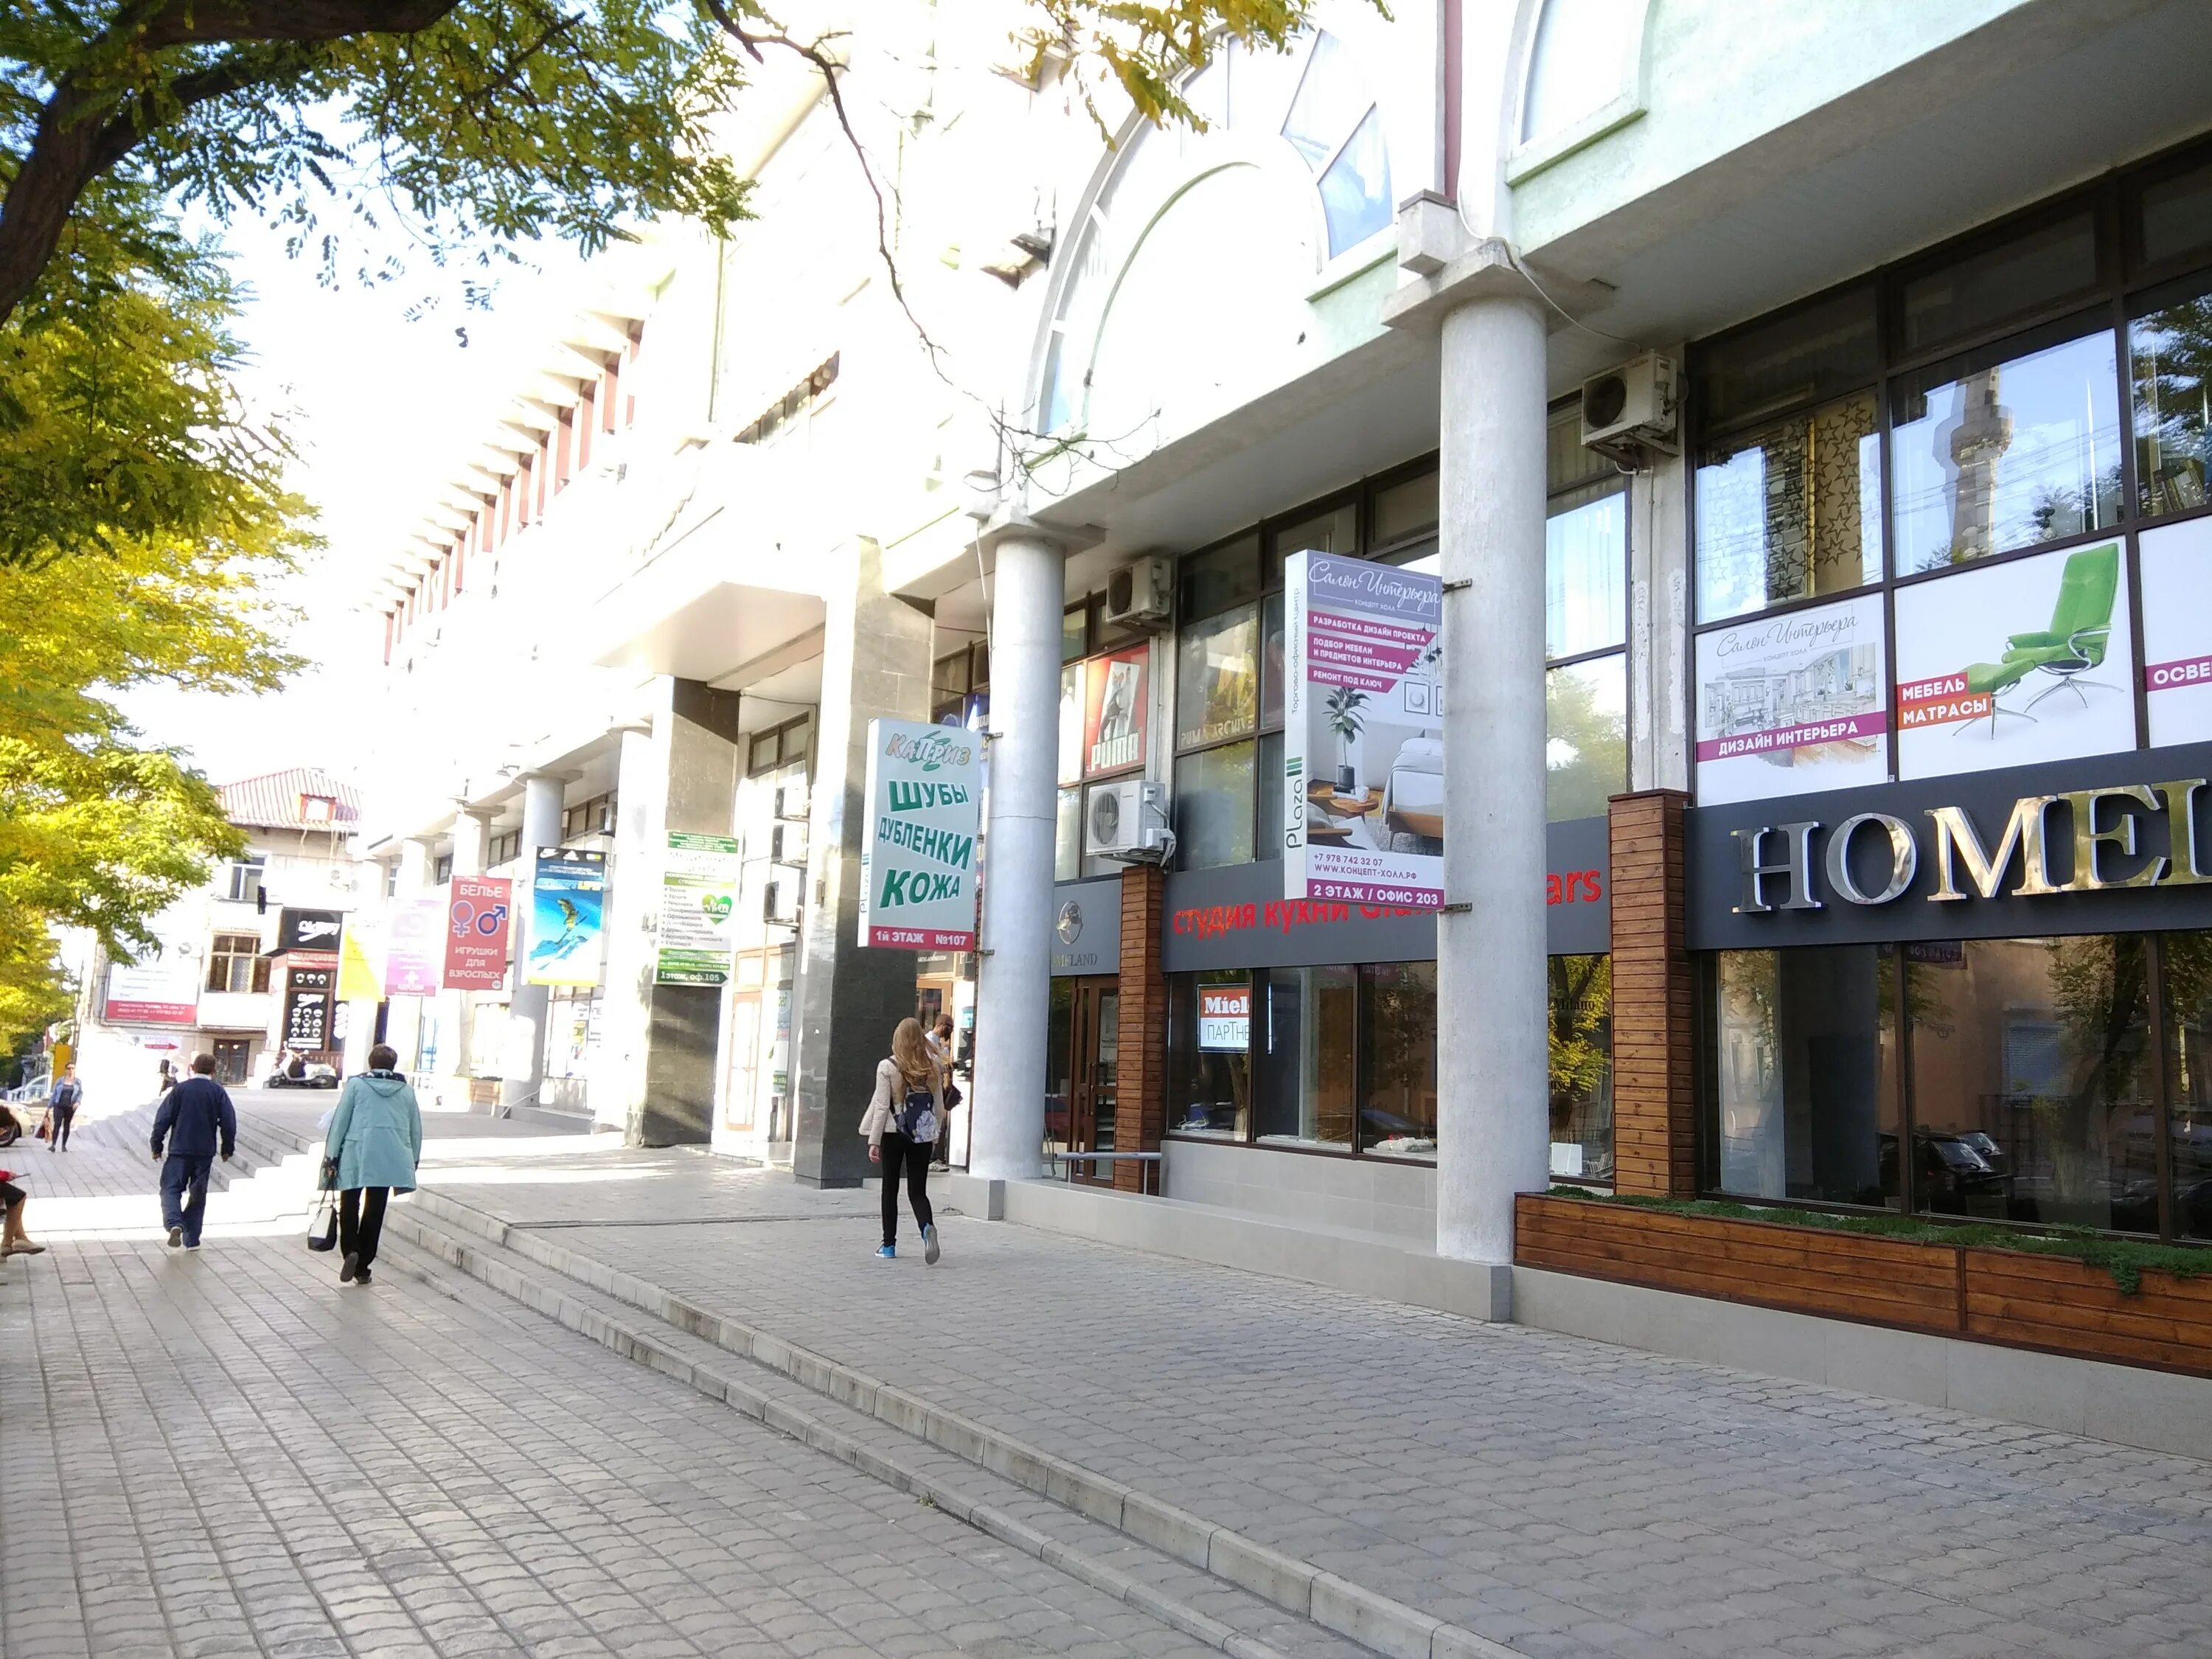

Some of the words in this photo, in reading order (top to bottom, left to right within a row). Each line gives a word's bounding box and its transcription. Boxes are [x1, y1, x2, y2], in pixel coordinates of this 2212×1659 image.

[1308, 561, 1360, 589] Салон
[1358, 571, 1440, 612] Интерьера
[1354, 599, 1379, 609] КОНЦЕПТ
[1380, 603, 1396, 612] ХОЛЛ
[1313, 616, 1362, 632] РАЗРАБОТКА
[1363, 625, 1392, 637] ДИЗАЙН
[1393, 630, 1426, 642] ПРОЕКТА
[1717, 633, 1767, 657] Салон
[1766, 615, 1859, 647] Интерьера
[1313, 637, 1343, 650] ПОДБОР
[1345, 643, 1373, 655] МЕБЕЛИ
[1763, 650, 1790, 662] КОНЦЕПТ
[1320, 650, 1362, 664] ПРЕДМЕТОВ
[1363, 658, 1402, 670] ИНТЕРЬЕРА
[1313, 670, 1342, 682] РЕМОНТ
[1343, 675, 1359, 685] ПОД
[1360, 678, 1382, 689] КЛЮЧ
[2154, 661, 2212, 684] ОСВЕ
[1902, 678, 1966, 701] МЕБЕЛЬ
[1903, 698, 1988, 725] МАТРАСЫ
[1719, 734, 1773, 756] ДИЗАЙН
[1776, 720, 1858, 745] ИНТЕРЬЕРА
[1091, 732, 1139, 772] PUMA
[888, 780, 970, 812] ШУБЫ
[877, 816, 973, 871] ДУБЛЕНКИ
[1326, 854, 1341, 863] 978
[1343, 855, 1358, 864] 742
[1360, 857, 1371, 866] 32
[1373, 858, 1383, 866] 07
[1315, 864, 1417, 880] WWW.КОНЦЕПТ-ХОЛЛ.РФ
[459, 885, 504, 898] БЕЛЬЕ
[879, 869, 960, 909] КОЖА
[1314, 884, 1322, 896] 2
[1325, 886, 1364, 900] ЭТАЖ
[1377, 889, 1413, 904] ОФИС
[1416, 891, 1439, 905] 203
[876, 931, 889, 942] 1й
[891, 931, 925, 944] ЭТАЖ
[935, 933, 967, 946] №107
[455, 947, 498, 956] ИГРУШКИ
[465, 959, 486, 968] ДЛЯ
[448, 969, 501, 980] ВЗРОСЛЫХ
[1204, 996, 1250, 1015] Miel
